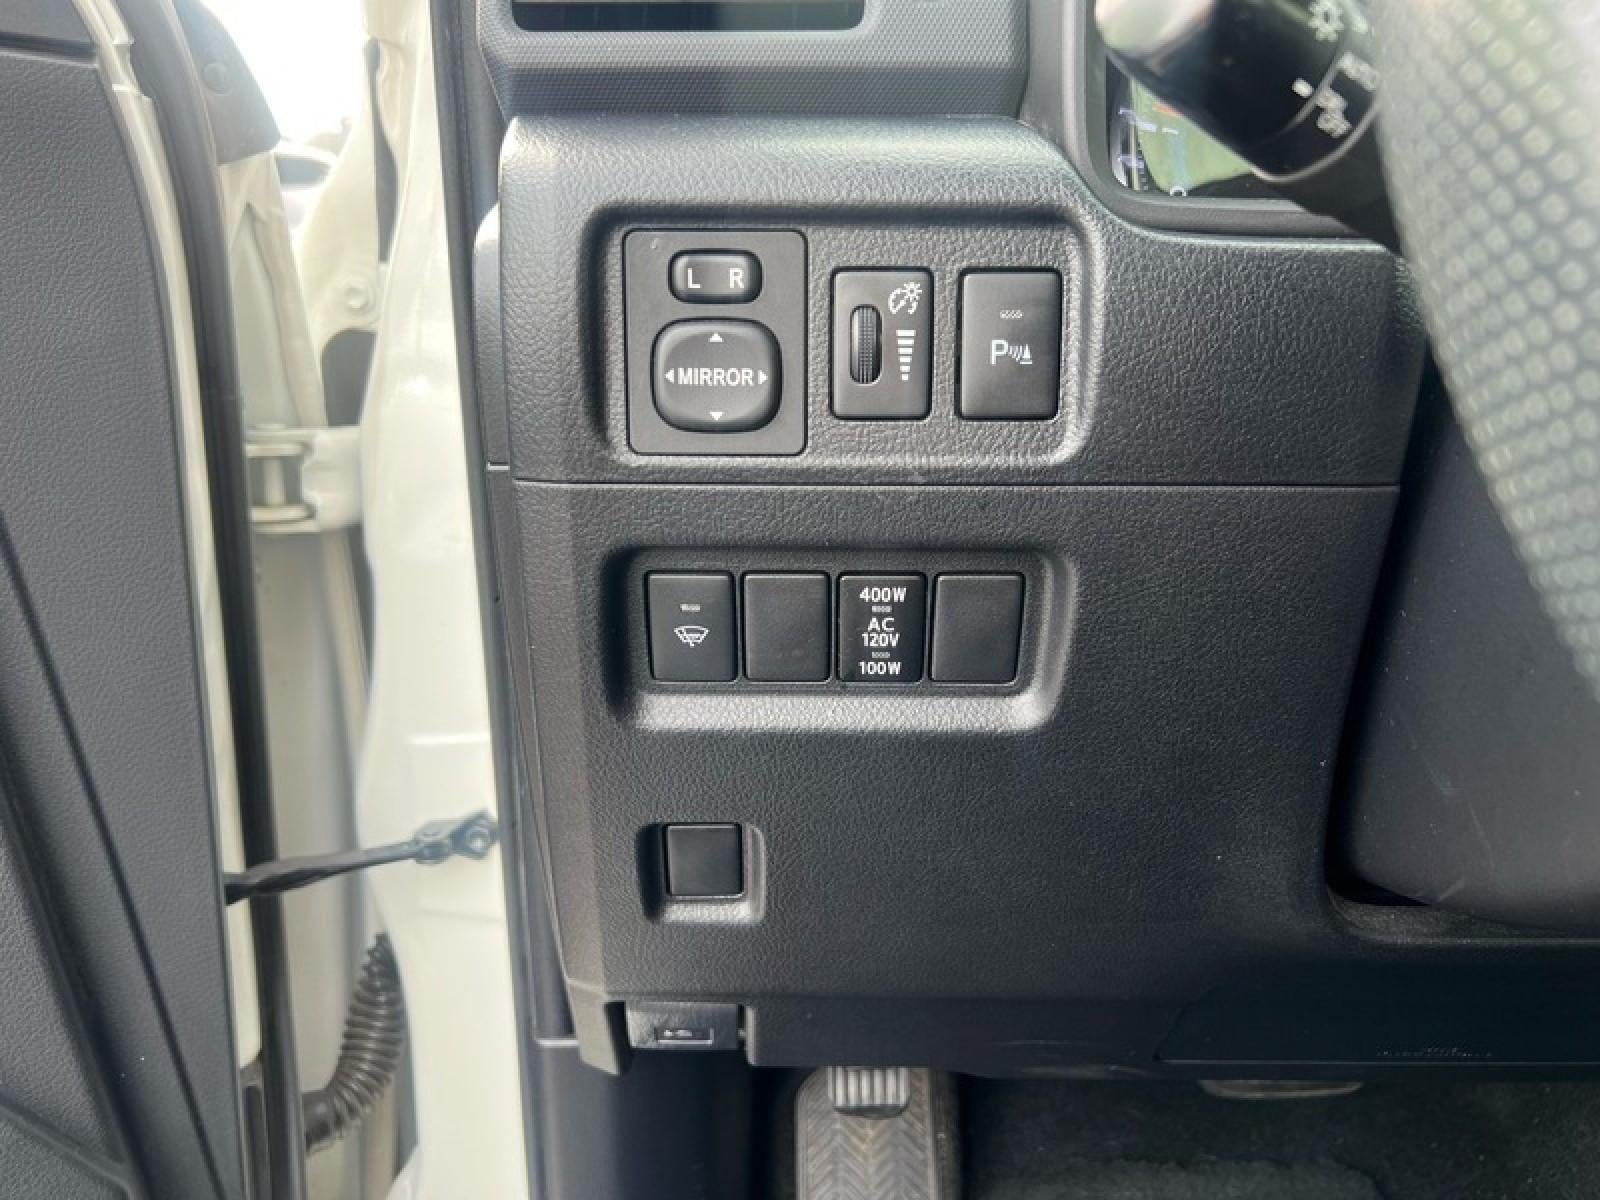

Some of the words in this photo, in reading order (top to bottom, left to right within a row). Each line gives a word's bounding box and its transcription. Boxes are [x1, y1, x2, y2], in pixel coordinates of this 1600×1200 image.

[687, 268, 701, 289] L
[729, 268, 745, 288] R
[678, 367, 754, 386] MIRROR
[859, 587, 907, 603] 400W
[868, 617, 895, 631] AC
[861, 632, 900, 647] 120V
[858, 661, 902, 675] 100W
